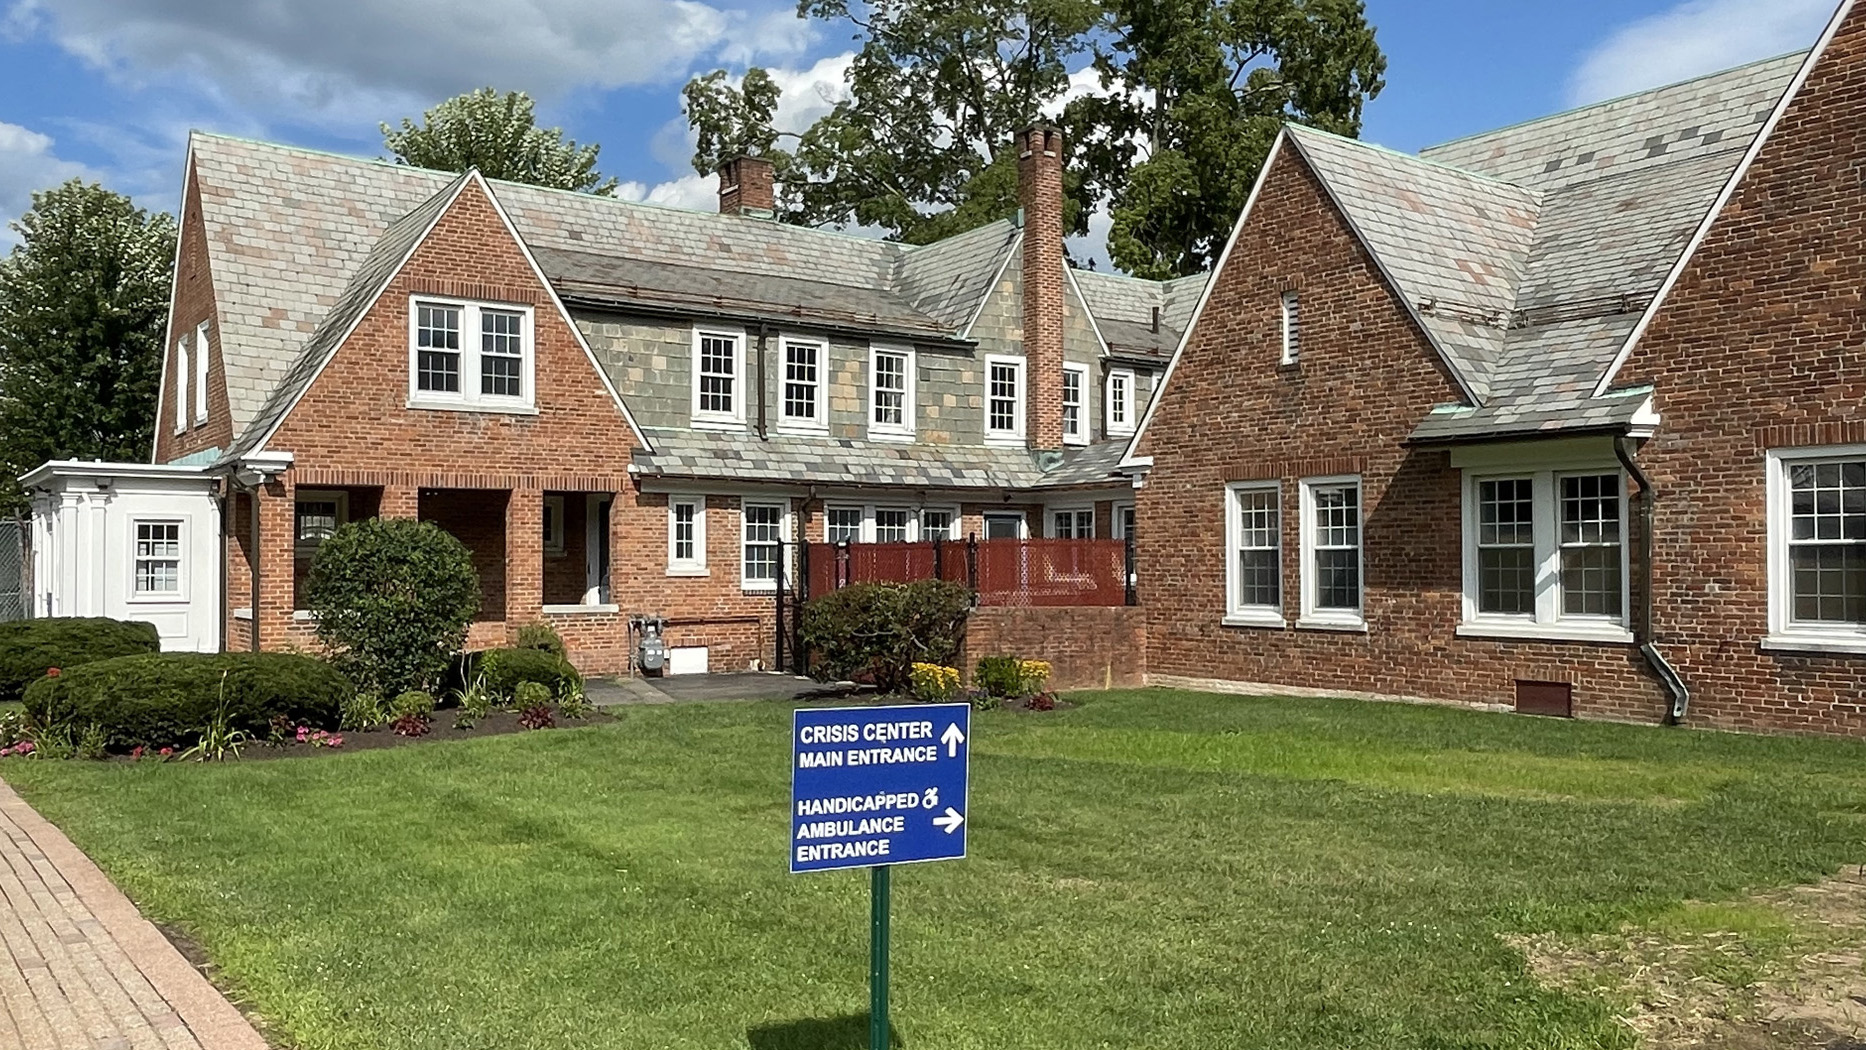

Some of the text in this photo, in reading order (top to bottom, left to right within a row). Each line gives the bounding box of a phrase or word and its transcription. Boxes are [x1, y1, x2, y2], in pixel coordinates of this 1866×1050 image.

[800, 721, 933, 744] CRISIS CENTER
[799, 746, 937, 768] MAIN ENTRANCE
[797, 792, 919, 816] HANDICAPPED
[796, 816, 905, 839] AMBULANCE
[796, 839, 890, 862] ENTRANCE
